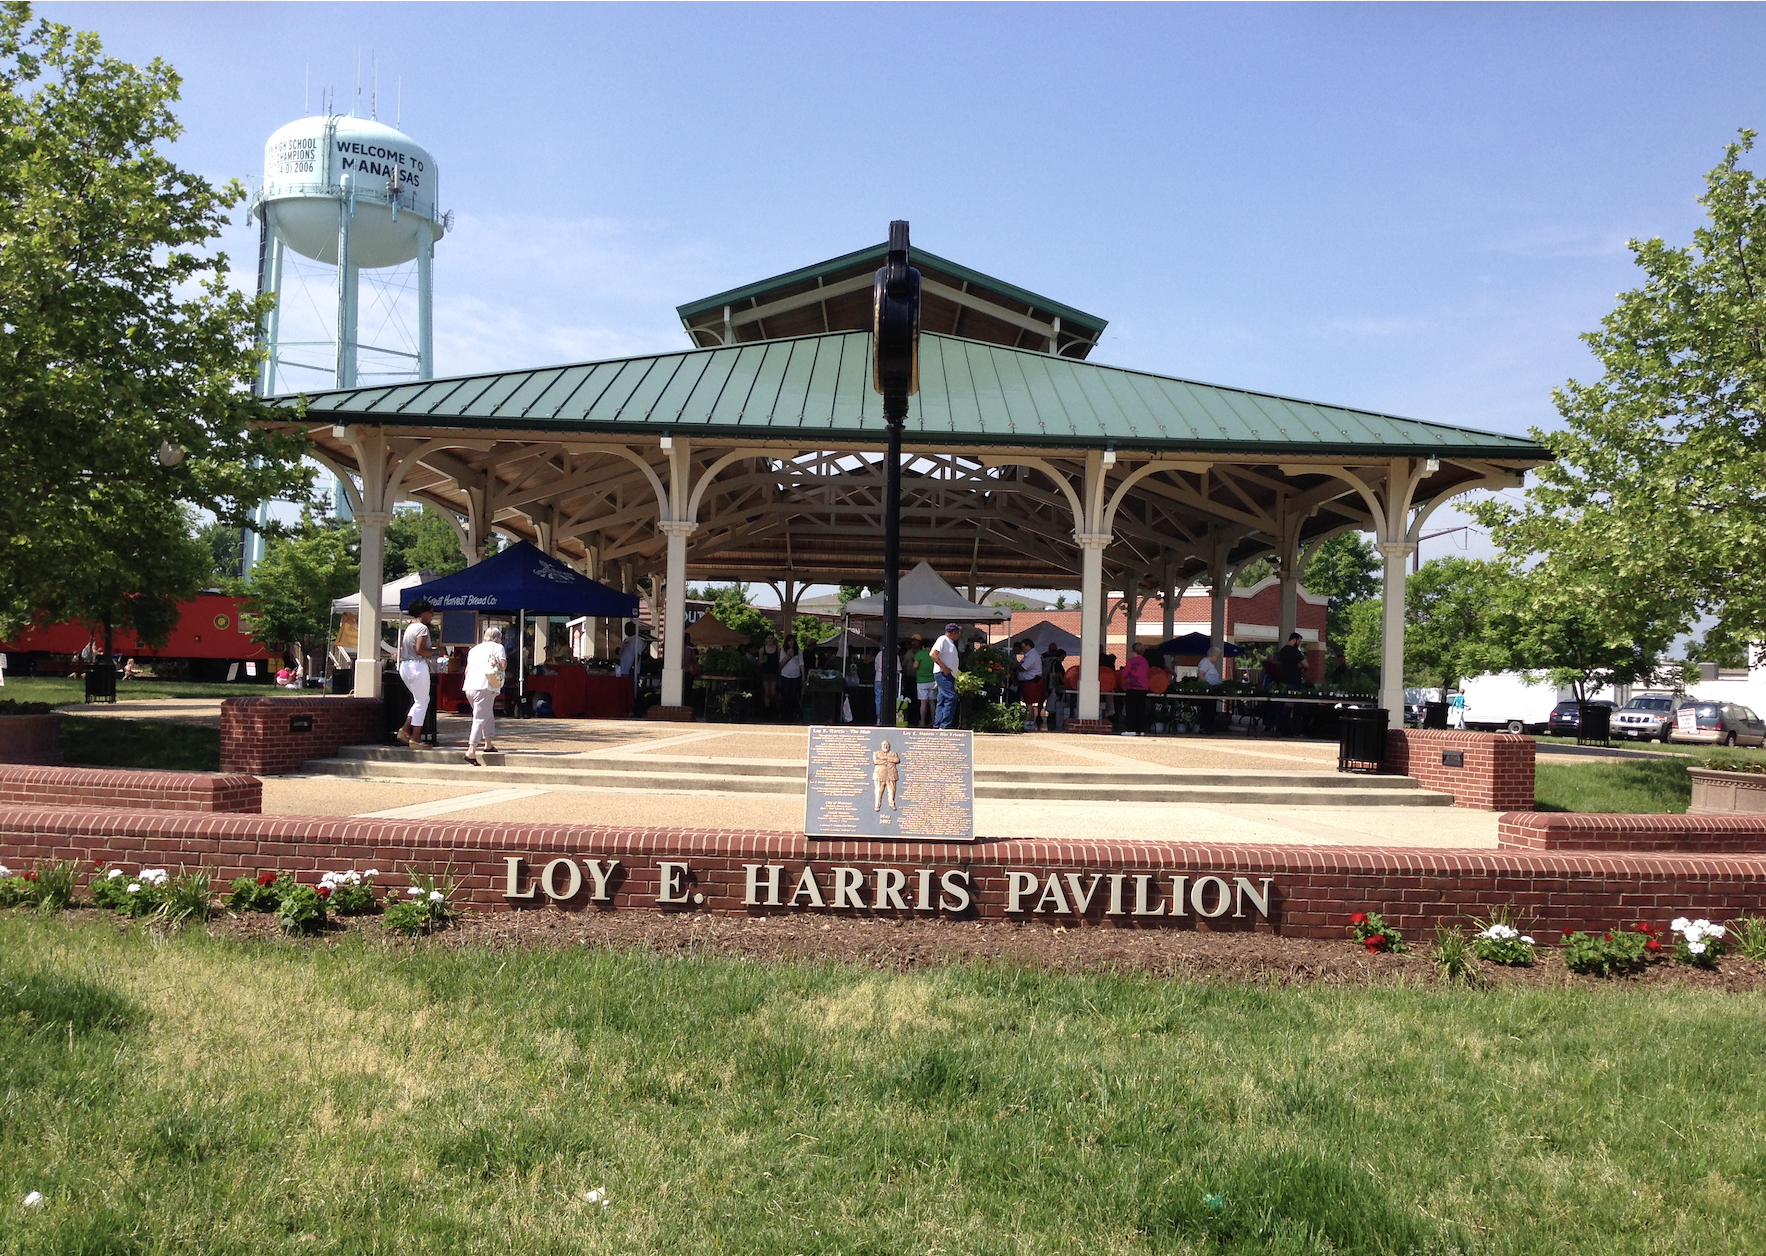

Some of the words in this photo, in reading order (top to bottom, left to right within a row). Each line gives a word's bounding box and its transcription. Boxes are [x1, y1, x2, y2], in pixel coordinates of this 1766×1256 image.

[288, 138, 317, 151] SCHOOL
[277, 149, 315, 164] CHAMPIONS
[337, 141, 405, 165] WELCOME
[410, 157, 424, 172] TO
[294, 161, 314, 173] 2006
[444, 594, 468, 606] Harvest
[467, 594, 488, 606] Bread
[502, 856, 620, 901] LOY
[655, 861, 704, 904] E.
[740, 863, 971, 912] HARRIS
[1003, 871, 1274, 918] PAVILION
